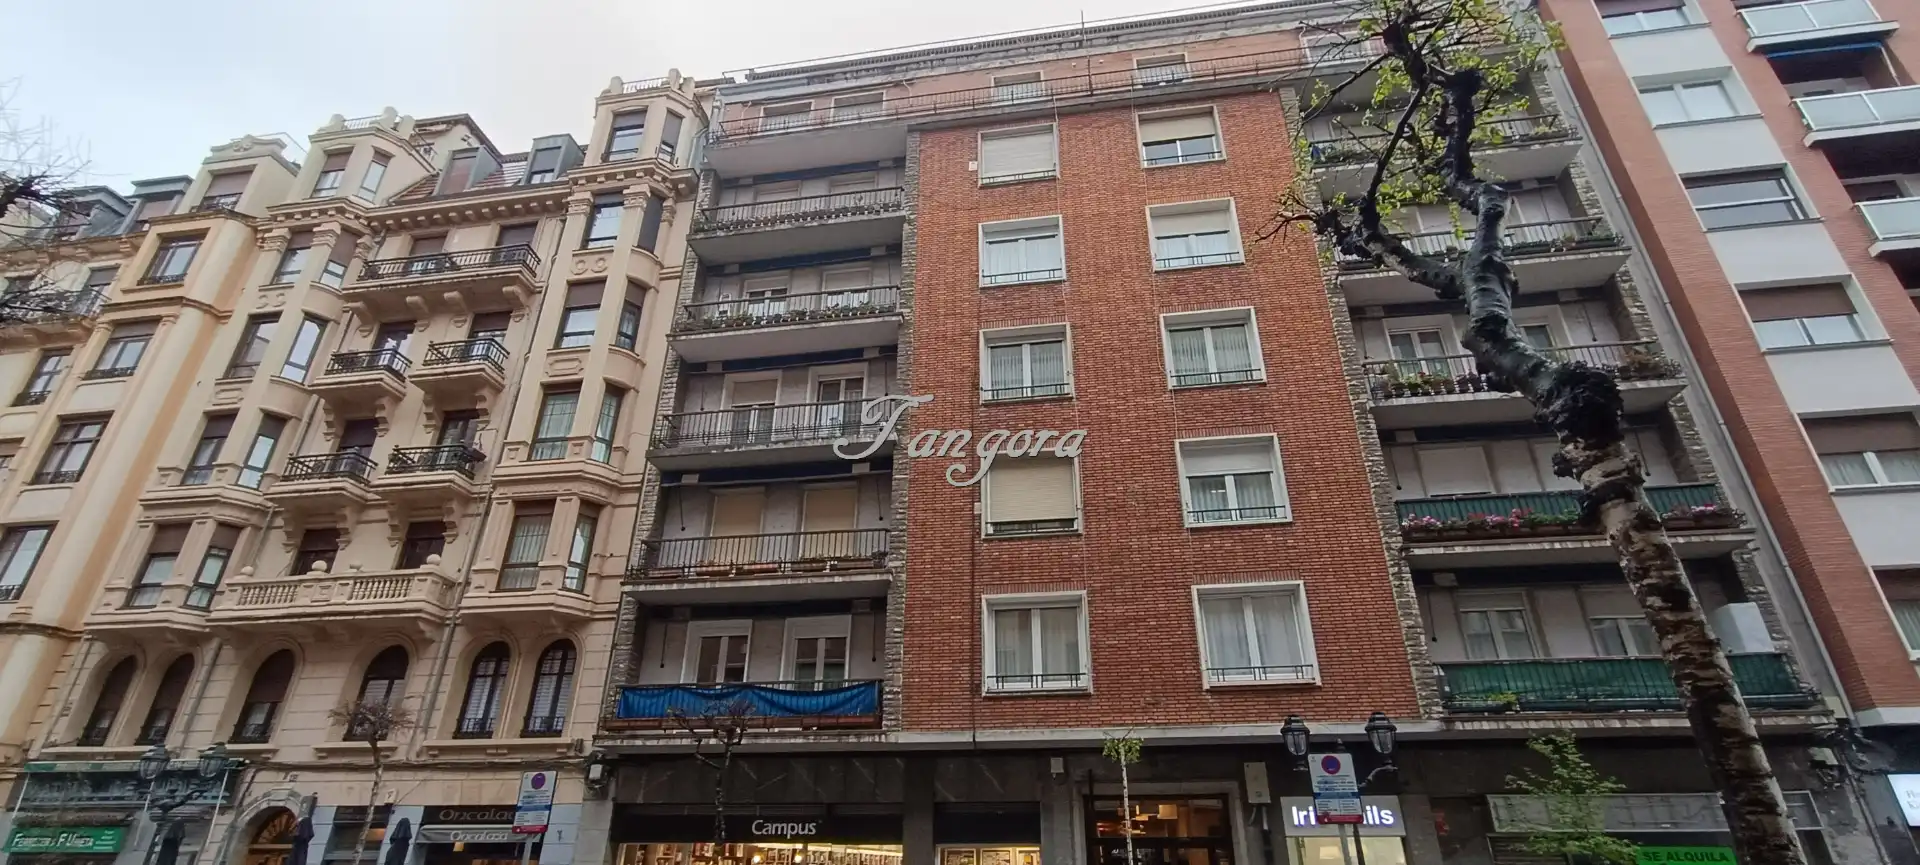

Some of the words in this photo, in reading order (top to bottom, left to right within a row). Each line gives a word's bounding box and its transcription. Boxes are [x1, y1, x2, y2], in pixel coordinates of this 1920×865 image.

[1291, 805, 1318, 826] Iri
[752, 819, 816, 839] Campus
[1642, 851, 1661, 861] SE
[1666, 851, 1731, 862] ALQUILA
